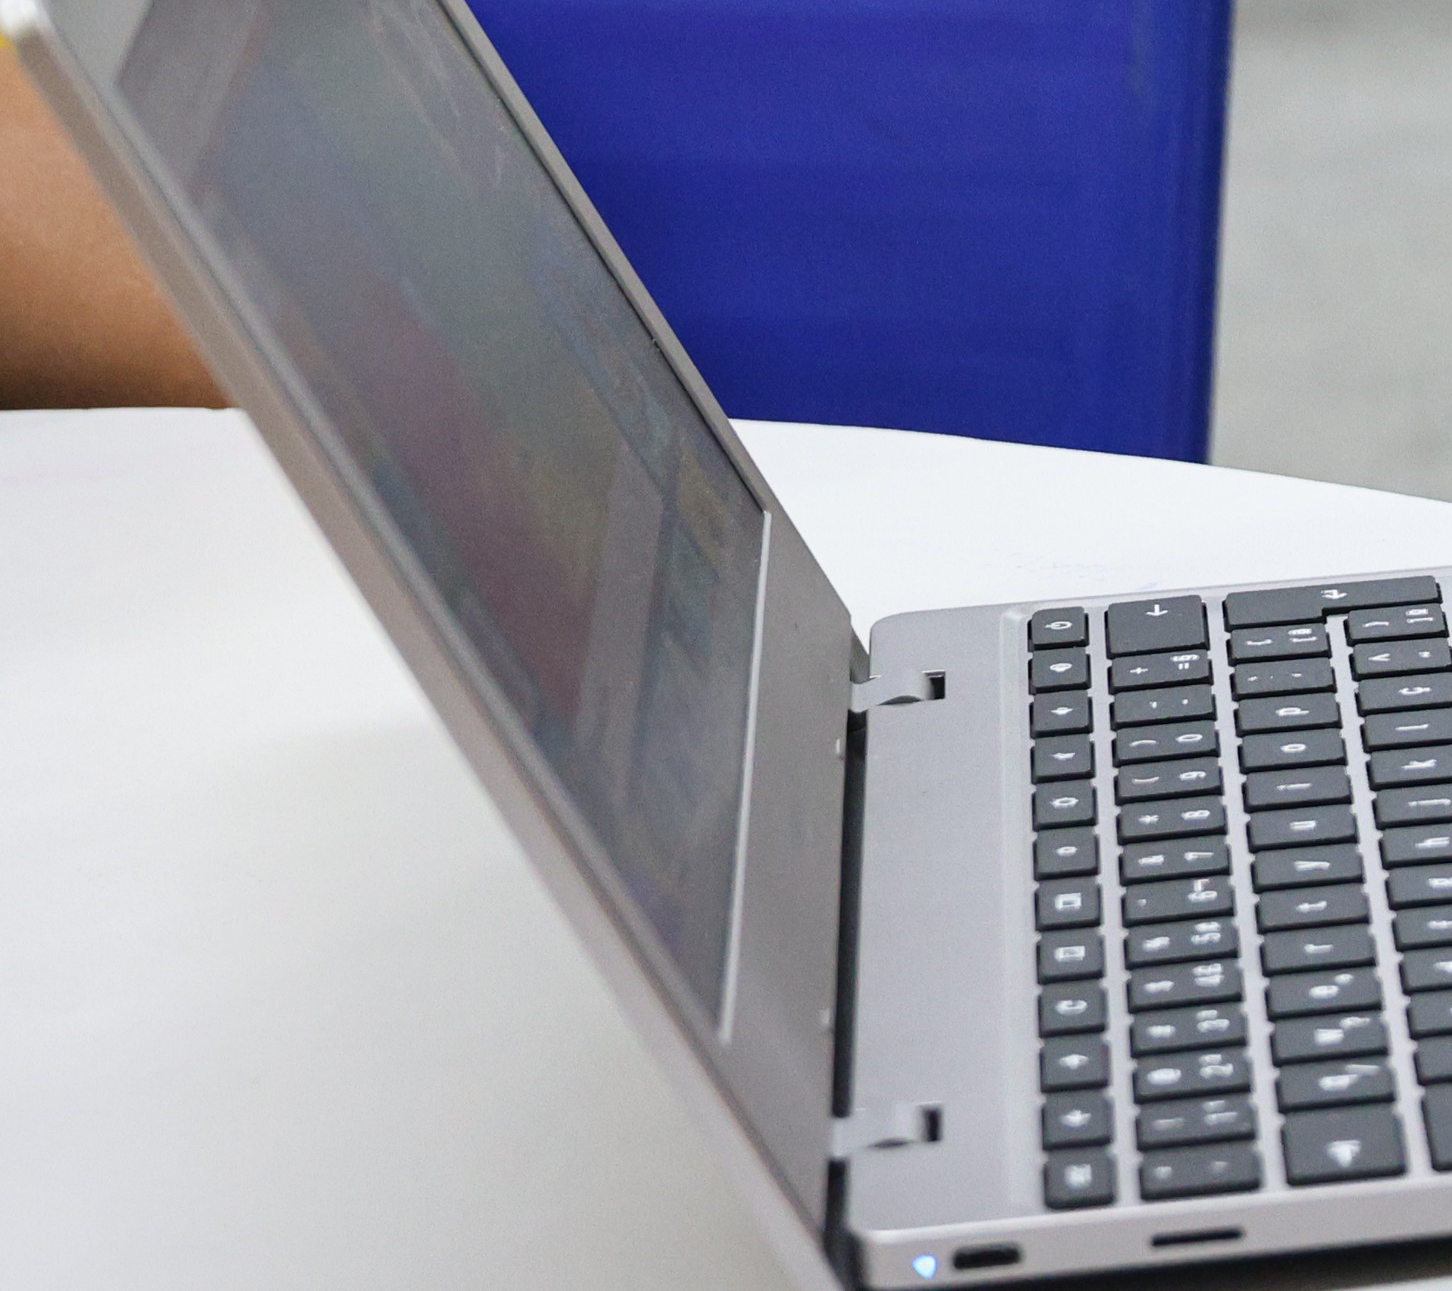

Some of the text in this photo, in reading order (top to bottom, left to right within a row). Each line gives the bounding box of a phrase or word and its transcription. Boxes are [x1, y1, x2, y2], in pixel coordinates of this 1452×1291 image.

[1129, 667, 1148, 675] +
[1398, 687, 1431, 695] ç
[1276, 707, 1309, 716] p
[1281, 744, 1307, 752] o
[1402, 760, 1436, 769] k
[1178, 771, 1207, 781] 9
[1277, 783, 1312, 791] i
[1408, 799, 1451, 807] j
[1180, 810, 1211, 820] 8
[1290, 820, 1317, 831] u
[1415, 837, 1450, 849] h
[1184, 852, 1215, 861] 7
[1294, 861, 1330, 871] y
[1187, 891, 1218, 901] 6
[1295, 900, 1327, 912] t
[1190, 932, 1221, 943] 5
[1304, 944, 1334, 953] r
[1194, 975, 1224, 986] 4
[1309, 985, 1339, 997] e
[1196, 1019, 1230, 1032] 3
[1199, 1063, 1233, 1078] 2
